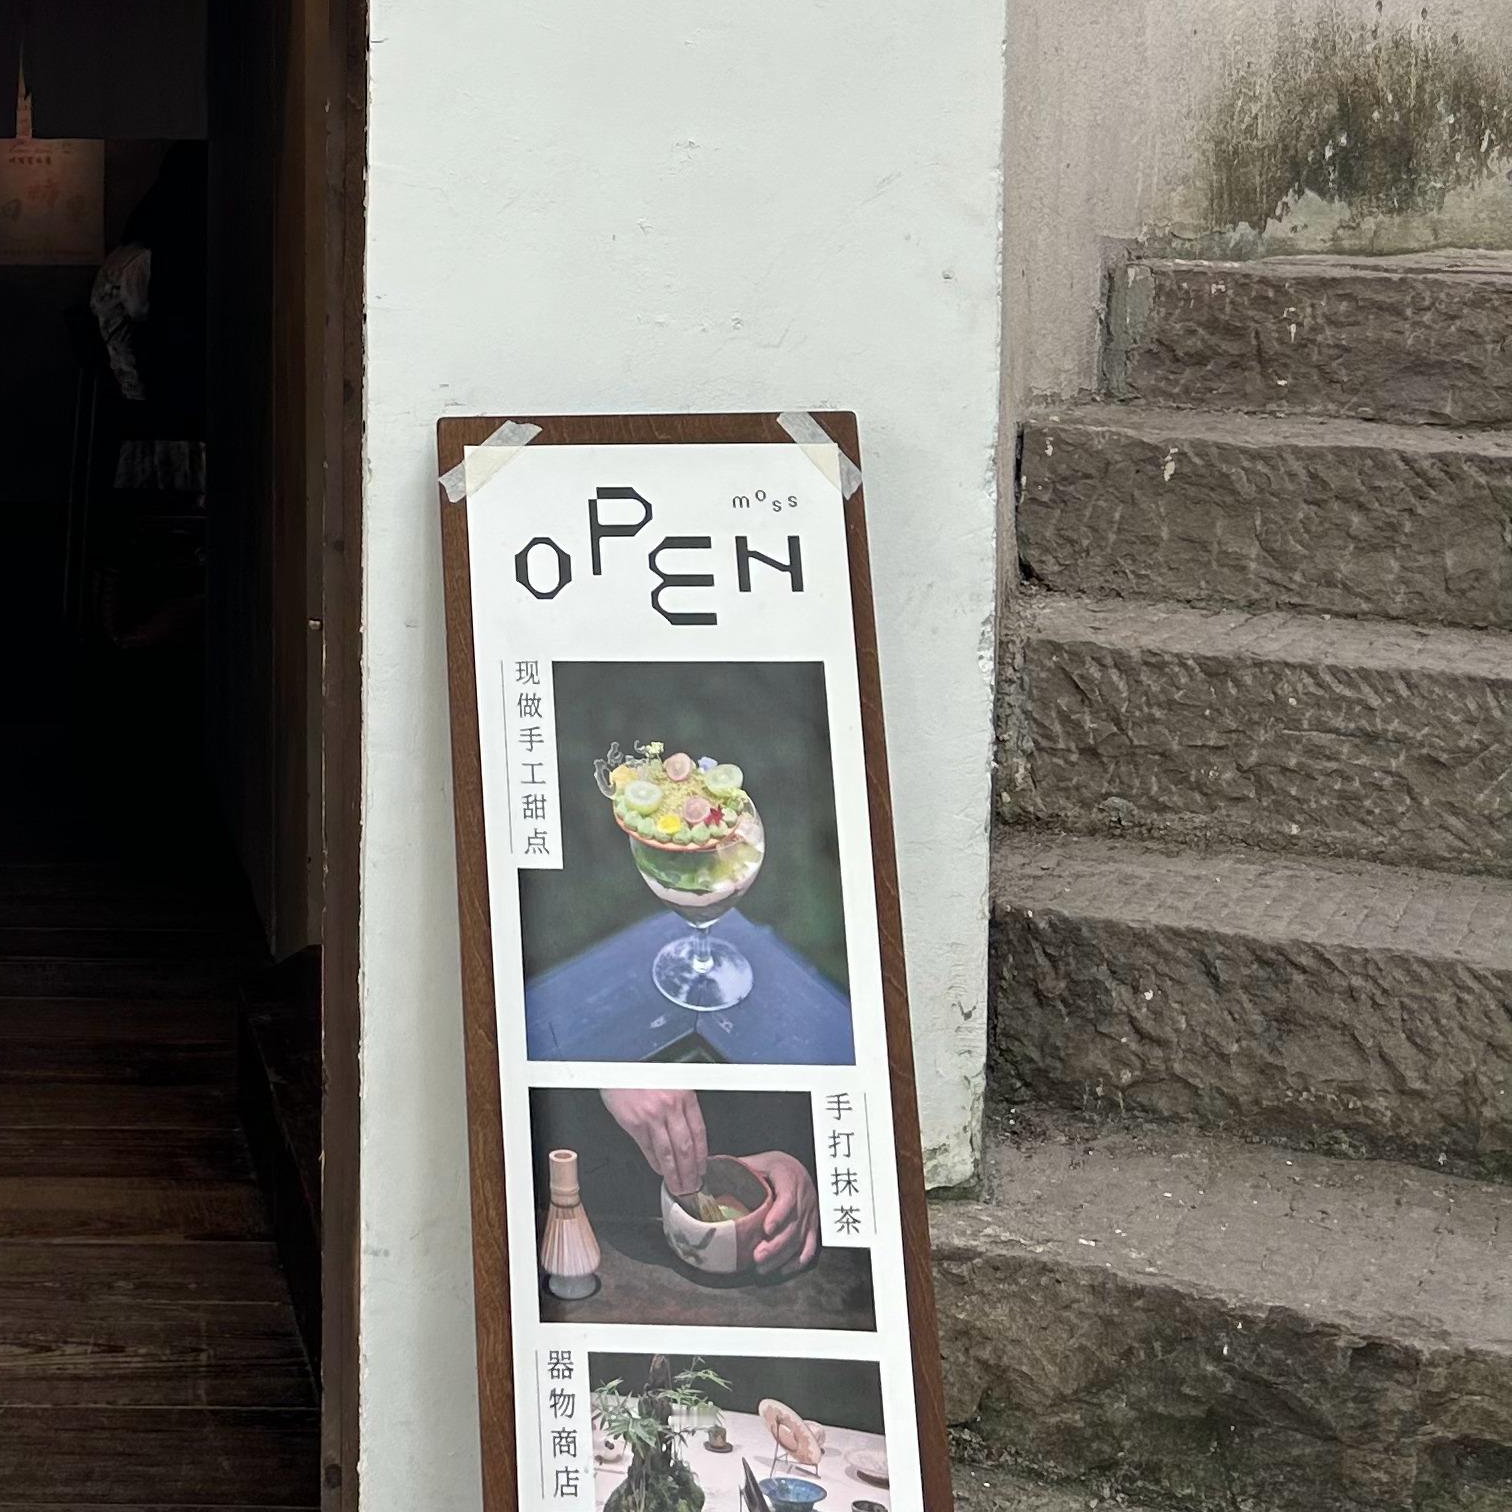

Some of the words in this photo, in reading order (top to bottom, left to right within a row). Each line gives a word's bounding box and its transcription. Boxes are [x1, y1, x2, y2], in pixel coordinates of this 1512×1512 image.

[515, 487, 804, 625] OPEN
[733, 489, 798, 513] moss
[515, 660, 550, 855] 现做手工甜点
[825, 1092, 861, 1235] 手打抹茶
[548, 1350, 580, 1499] 器物商店
